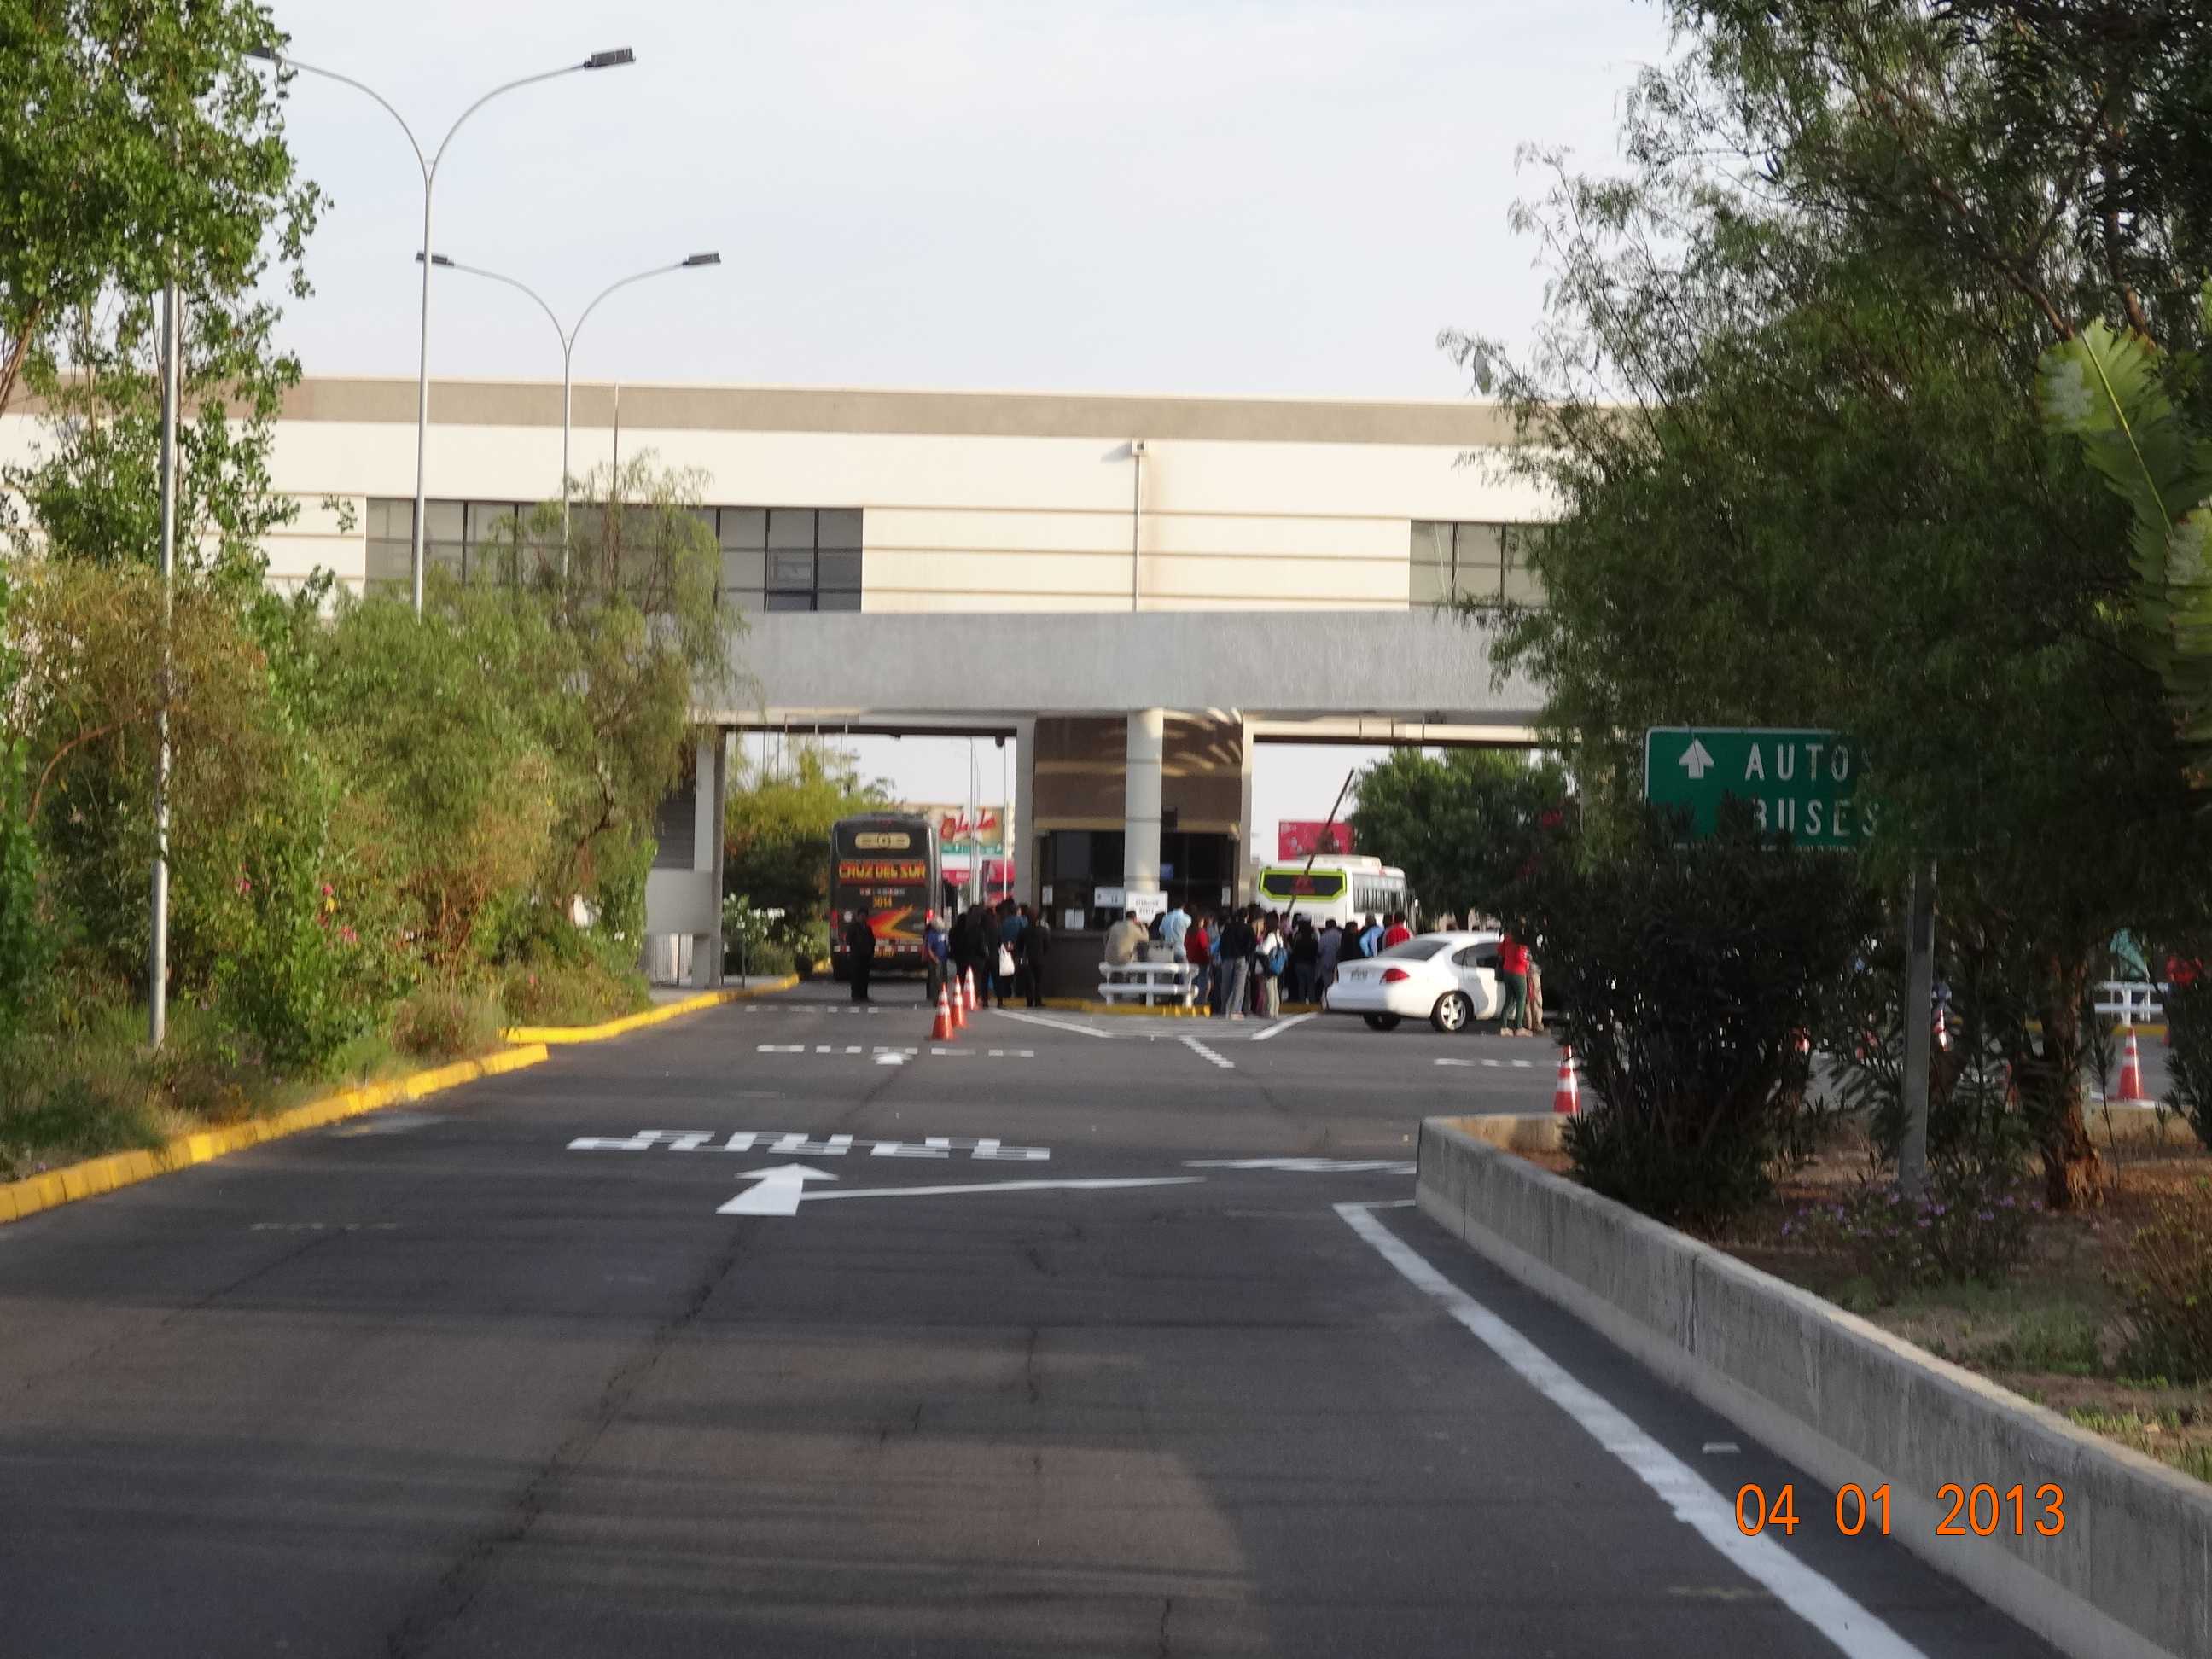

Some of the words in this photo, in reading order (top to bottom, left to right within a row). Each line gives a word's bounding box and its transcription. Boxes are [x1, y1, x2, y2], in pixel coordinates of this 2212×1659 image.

[1752, 797, 1880, 837] BUSES
[838, 861, 874, 880] CRUZ
[876, 862, 899, 880] DEL
[900, 862, 926, 880] SUR
